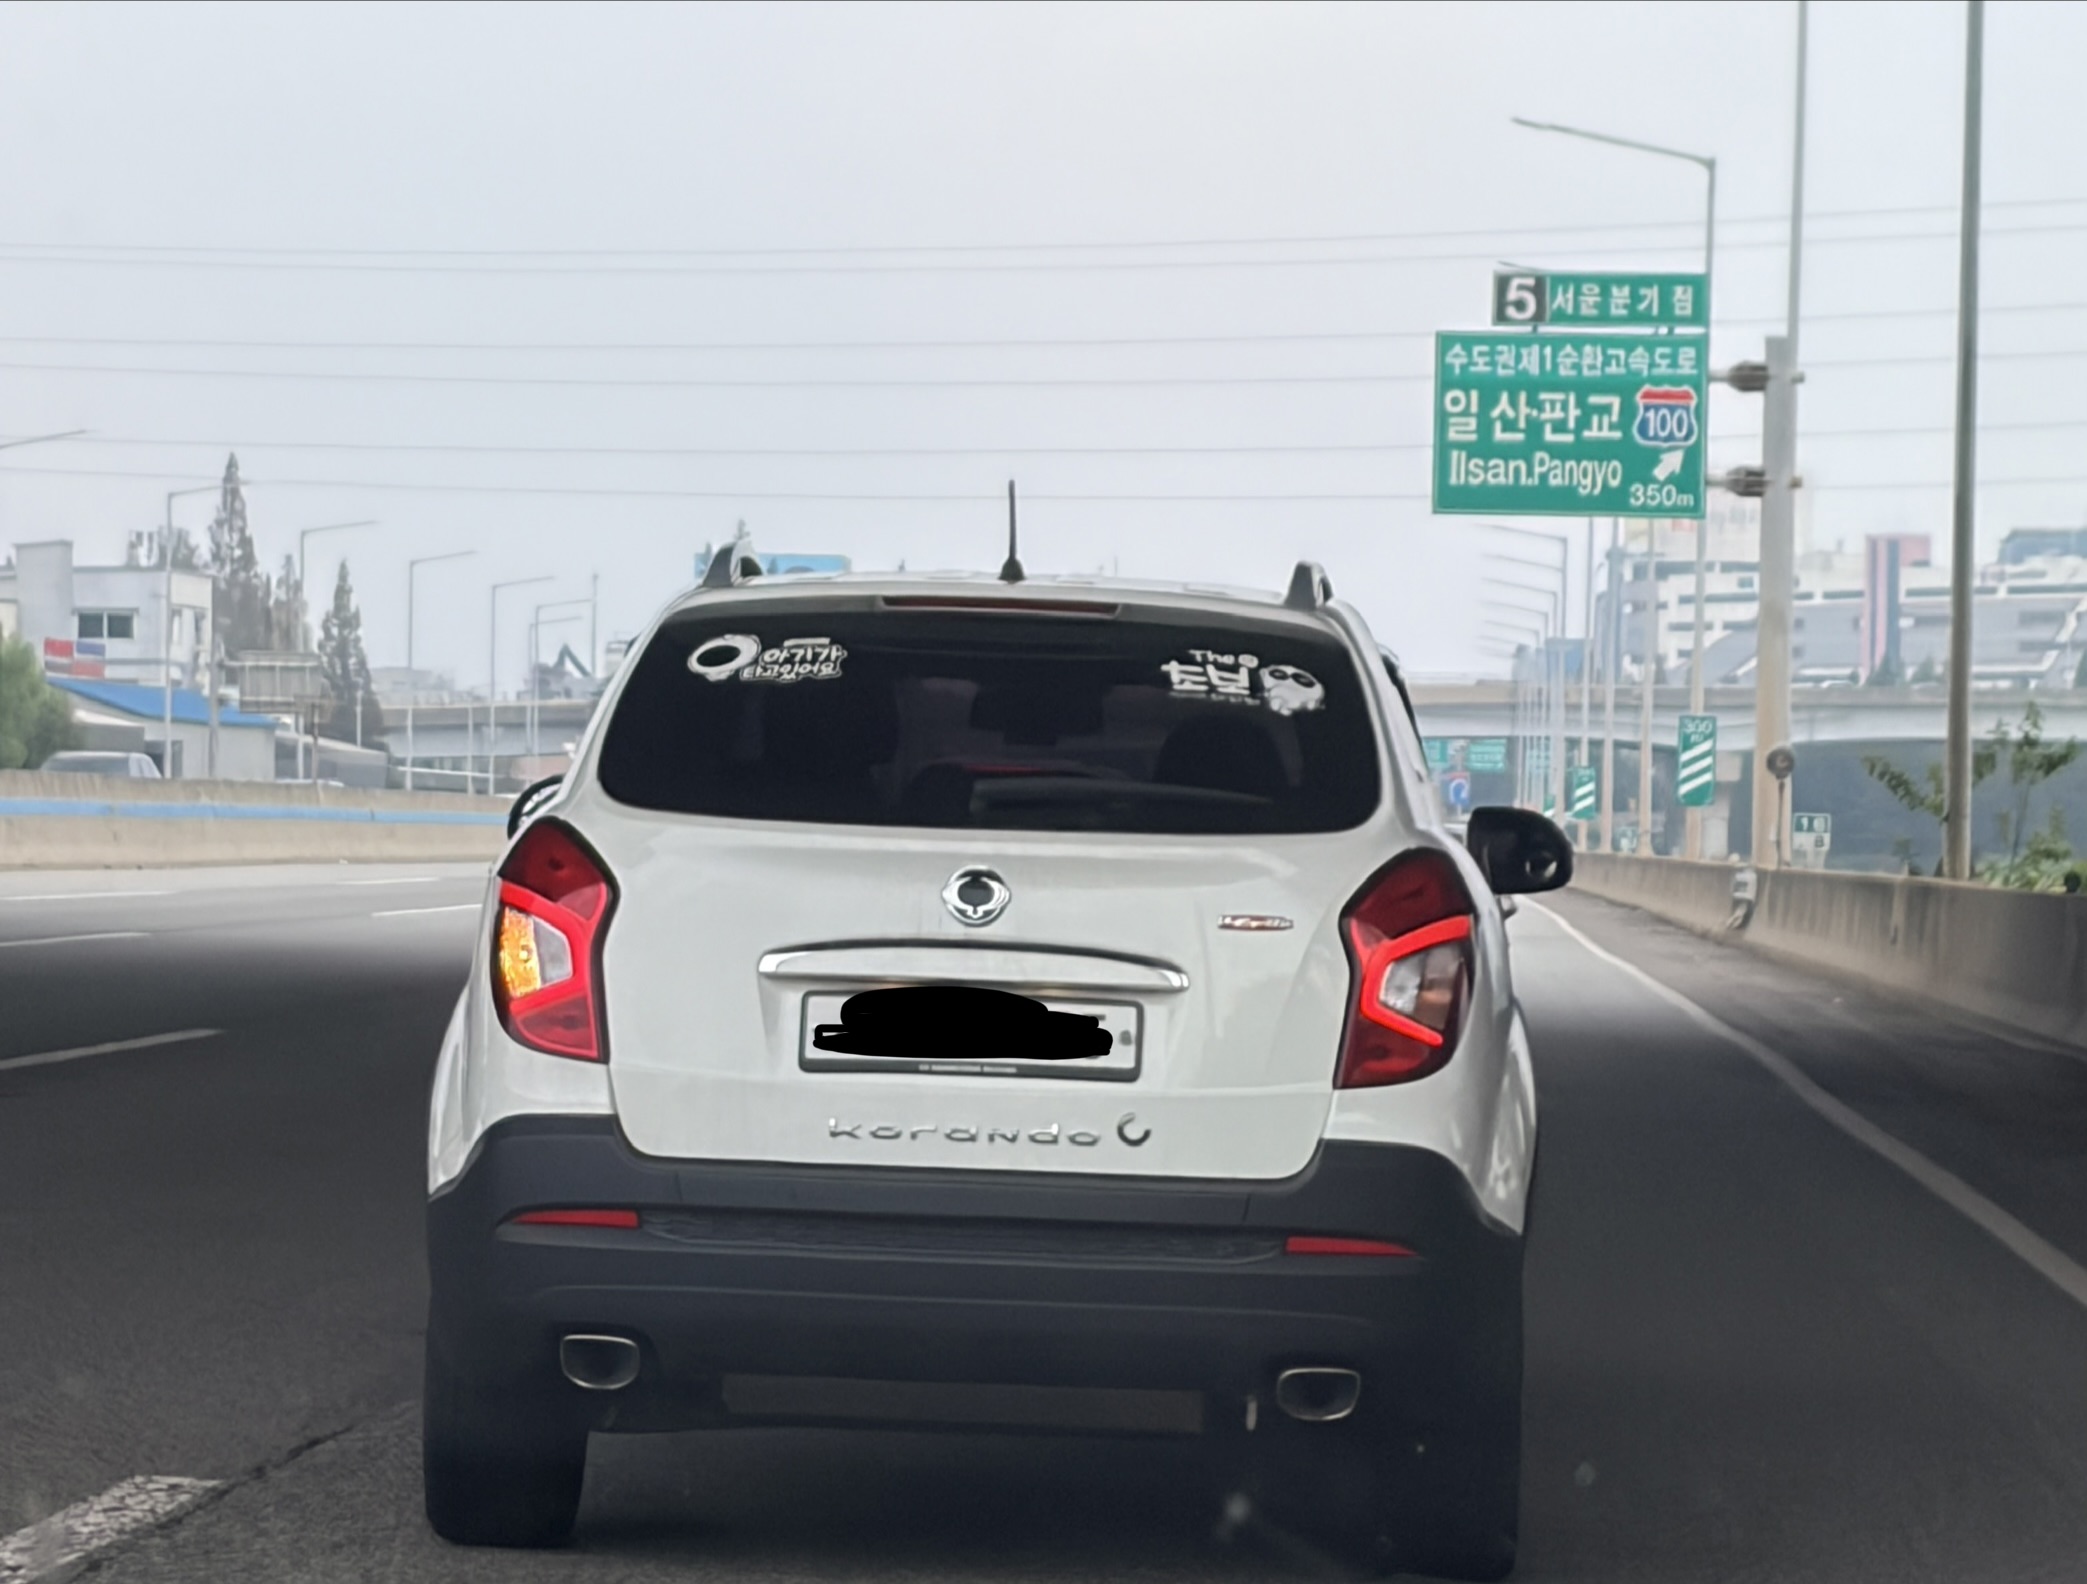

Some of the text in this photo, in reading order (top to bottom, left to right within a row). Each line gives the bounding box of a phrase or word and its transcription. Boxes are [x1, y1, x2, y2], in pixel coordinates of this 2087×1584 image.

[1504, 276, 1538, 320] 5
[1551, 283, 1694, 317] 서운분기점
[1444, 343, 1698, 376] 수도권제1순환고속도로
[1644, 407, 1689, 438] 100
[1629, 484, 1695, 507] 350m
[762, 645, 846, 664] 아기가
